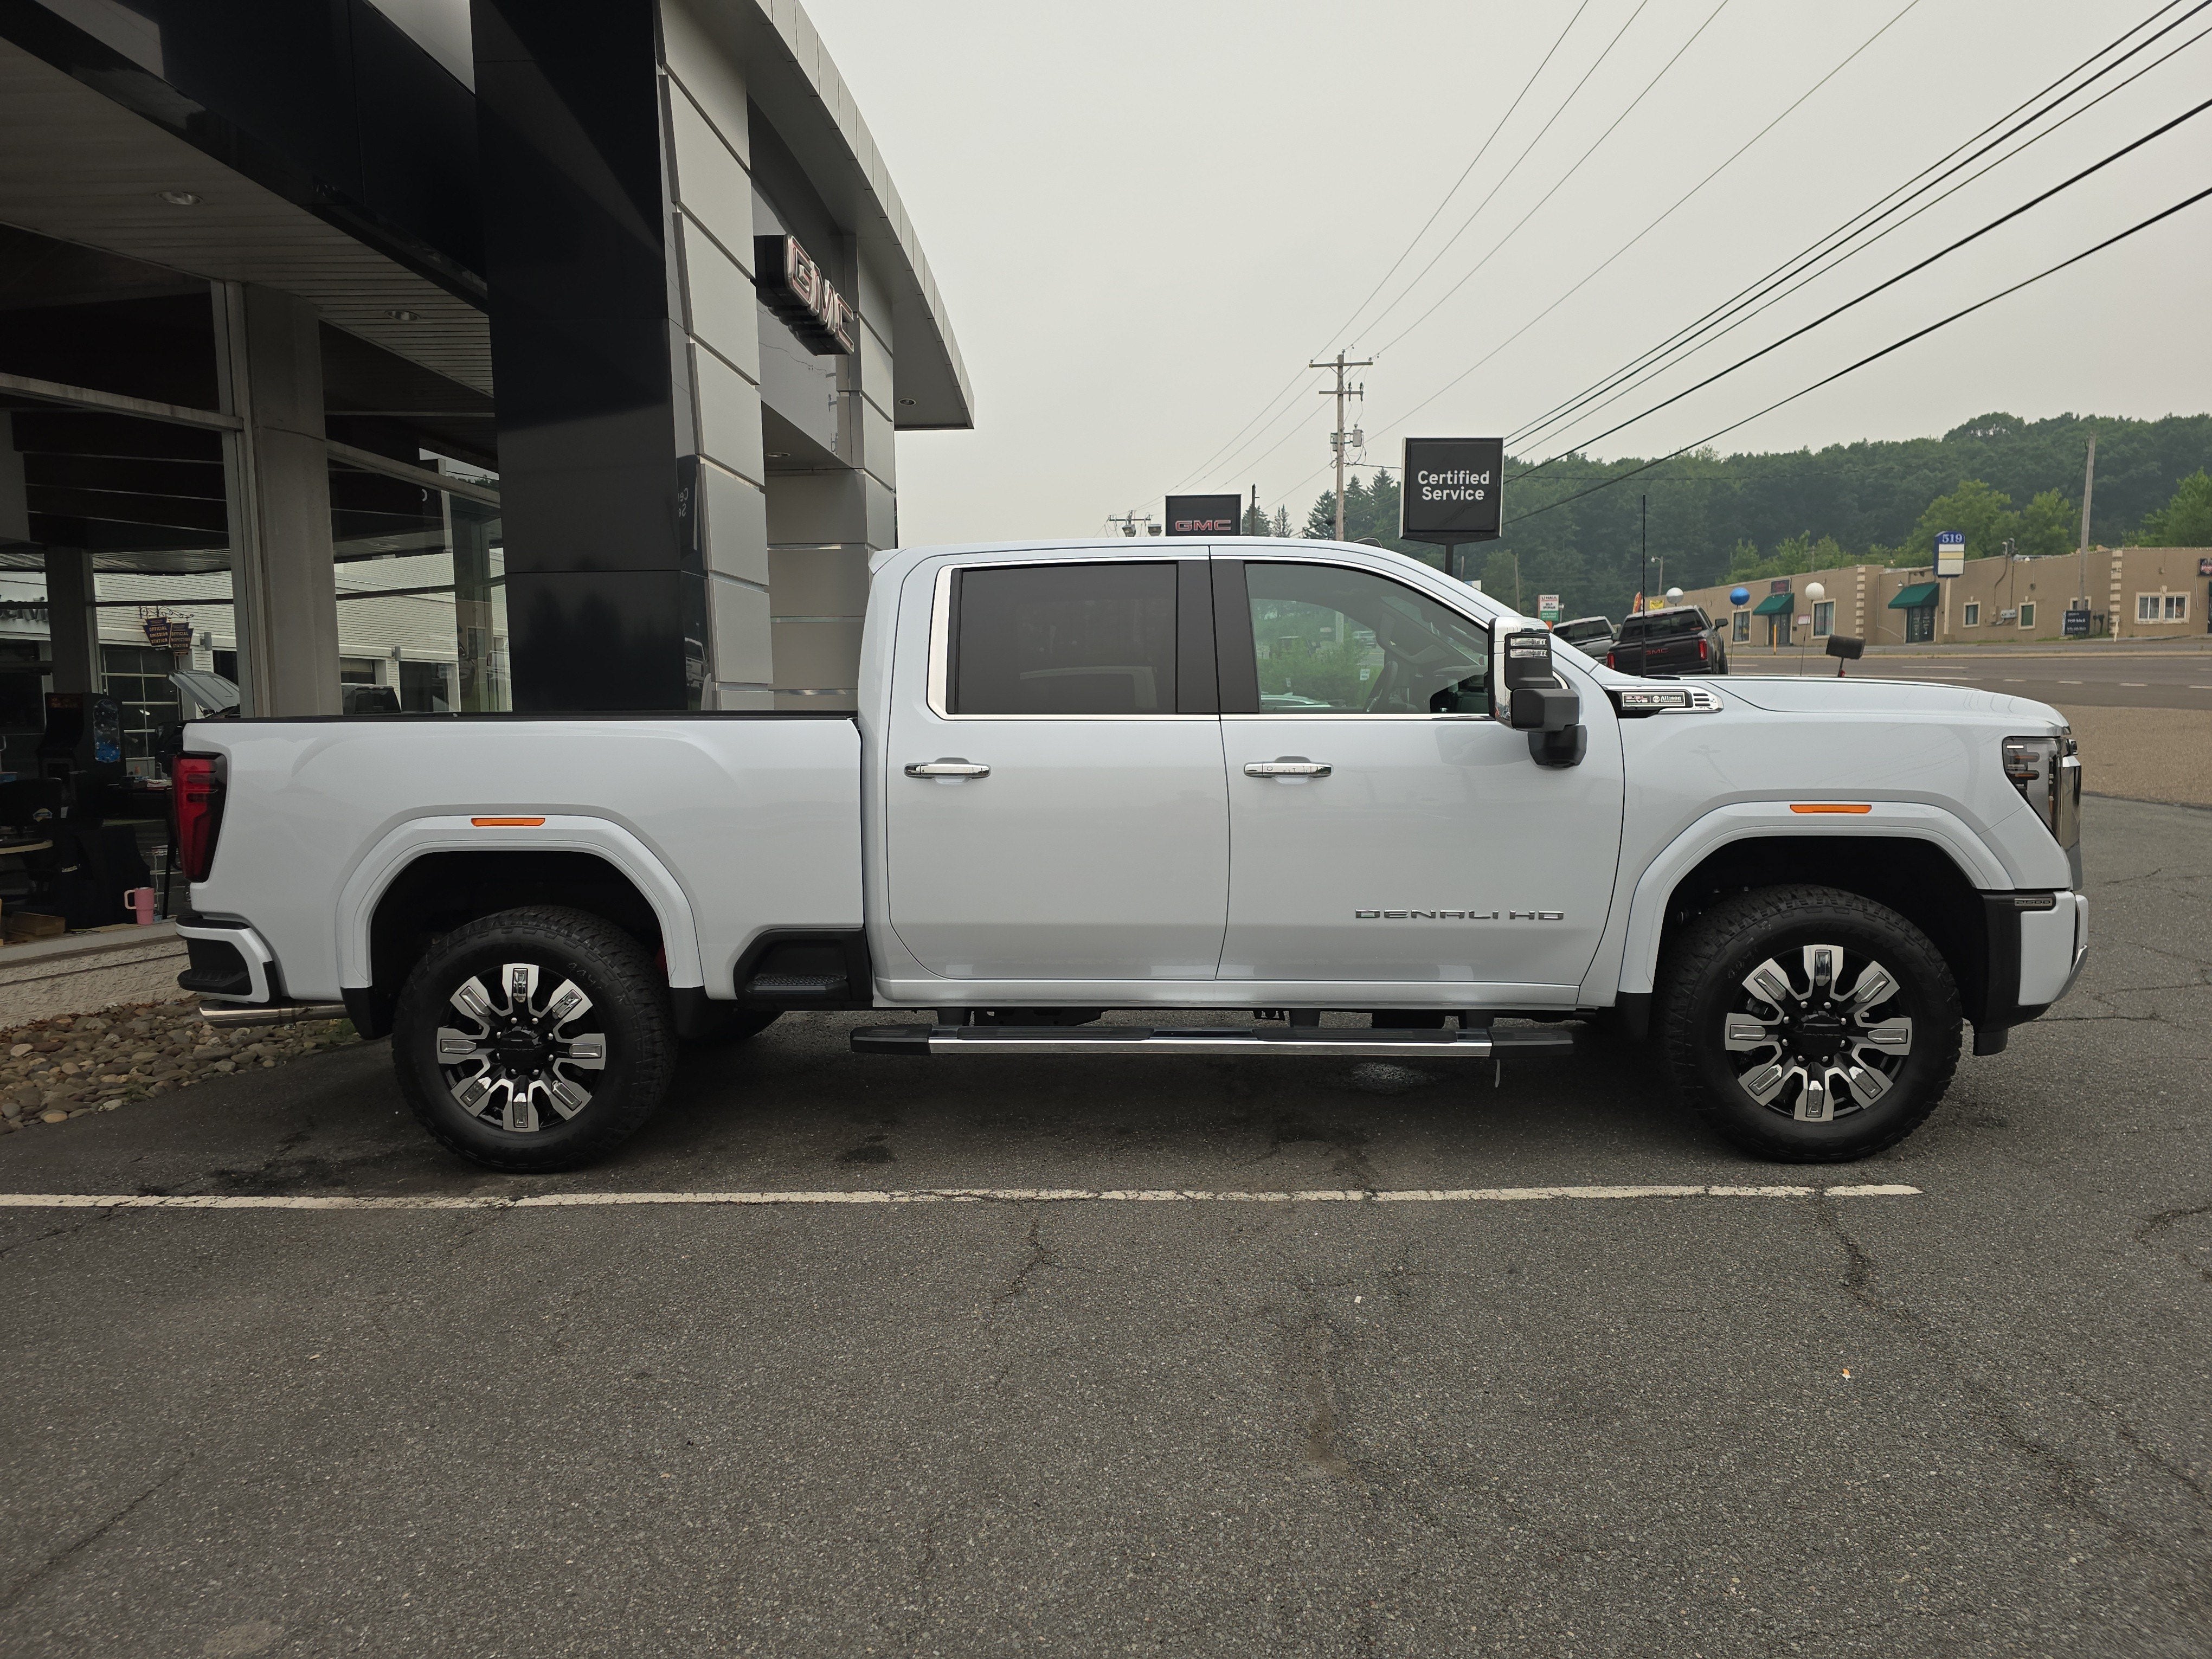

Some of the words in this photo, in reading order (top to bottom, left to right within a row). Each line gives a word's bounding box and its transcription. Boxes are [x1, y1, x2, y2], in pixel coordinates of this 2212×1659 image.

[786, 235, 854, 353] GMC
[1417, 470, 1490, 485] Certified
[1422, 486, 1485, 500] Service
[1175, 520, 1231, 531] GMC
[1942, 533, 1963, 543] 519
[1355, 909, 1500, 919] DENALI
[1509, 910, 1564, 920] HD
